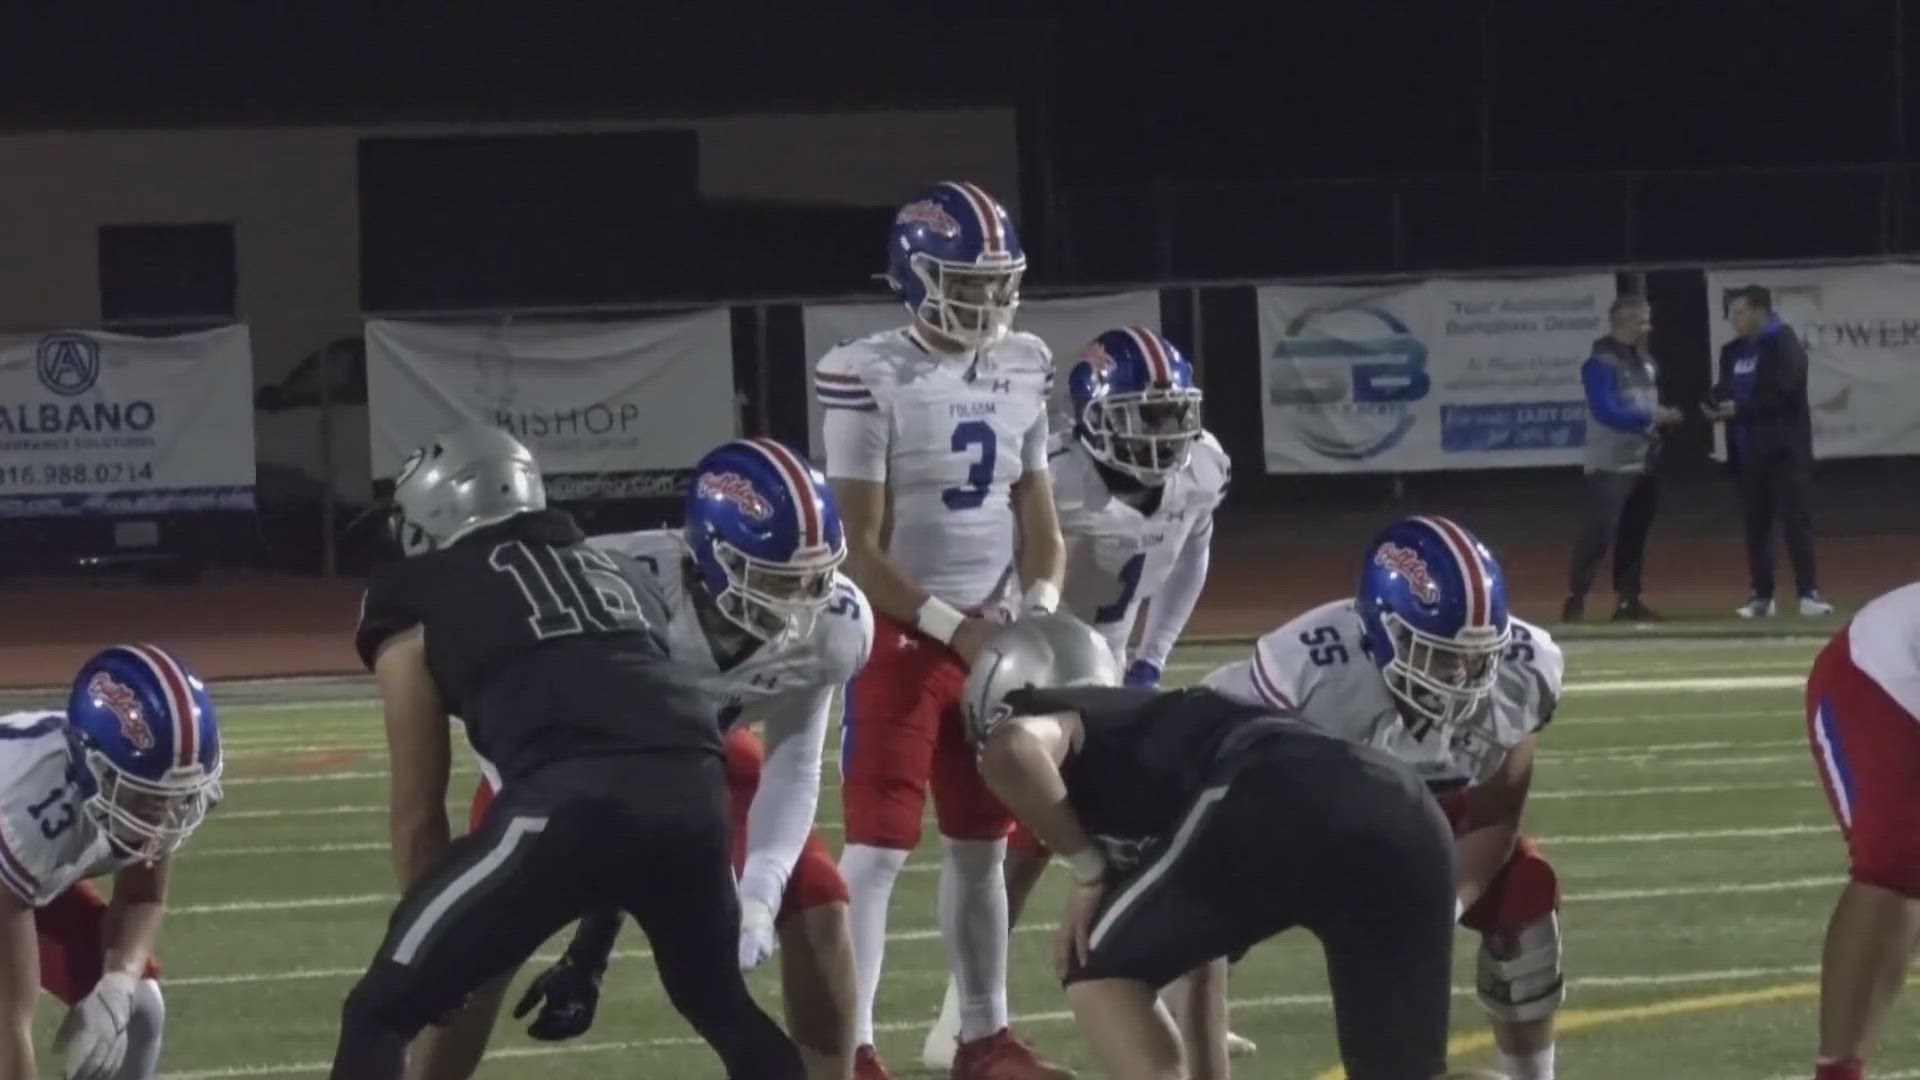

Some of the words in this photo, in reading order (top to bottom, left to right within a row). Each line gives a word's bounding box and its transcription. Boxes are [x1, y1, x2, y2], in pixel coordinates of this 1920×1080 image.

[0, 400, 155, 434] ALBANO
[948, 401, 997, 418] FOLSOM
[941, 420, 997, 511] 3
[488, 539, 652, 641] 16
[1094, 552, 1148, 624] 1
[1299, 624, 1350, 668] 55
[28, 786, 73, 840] 13
